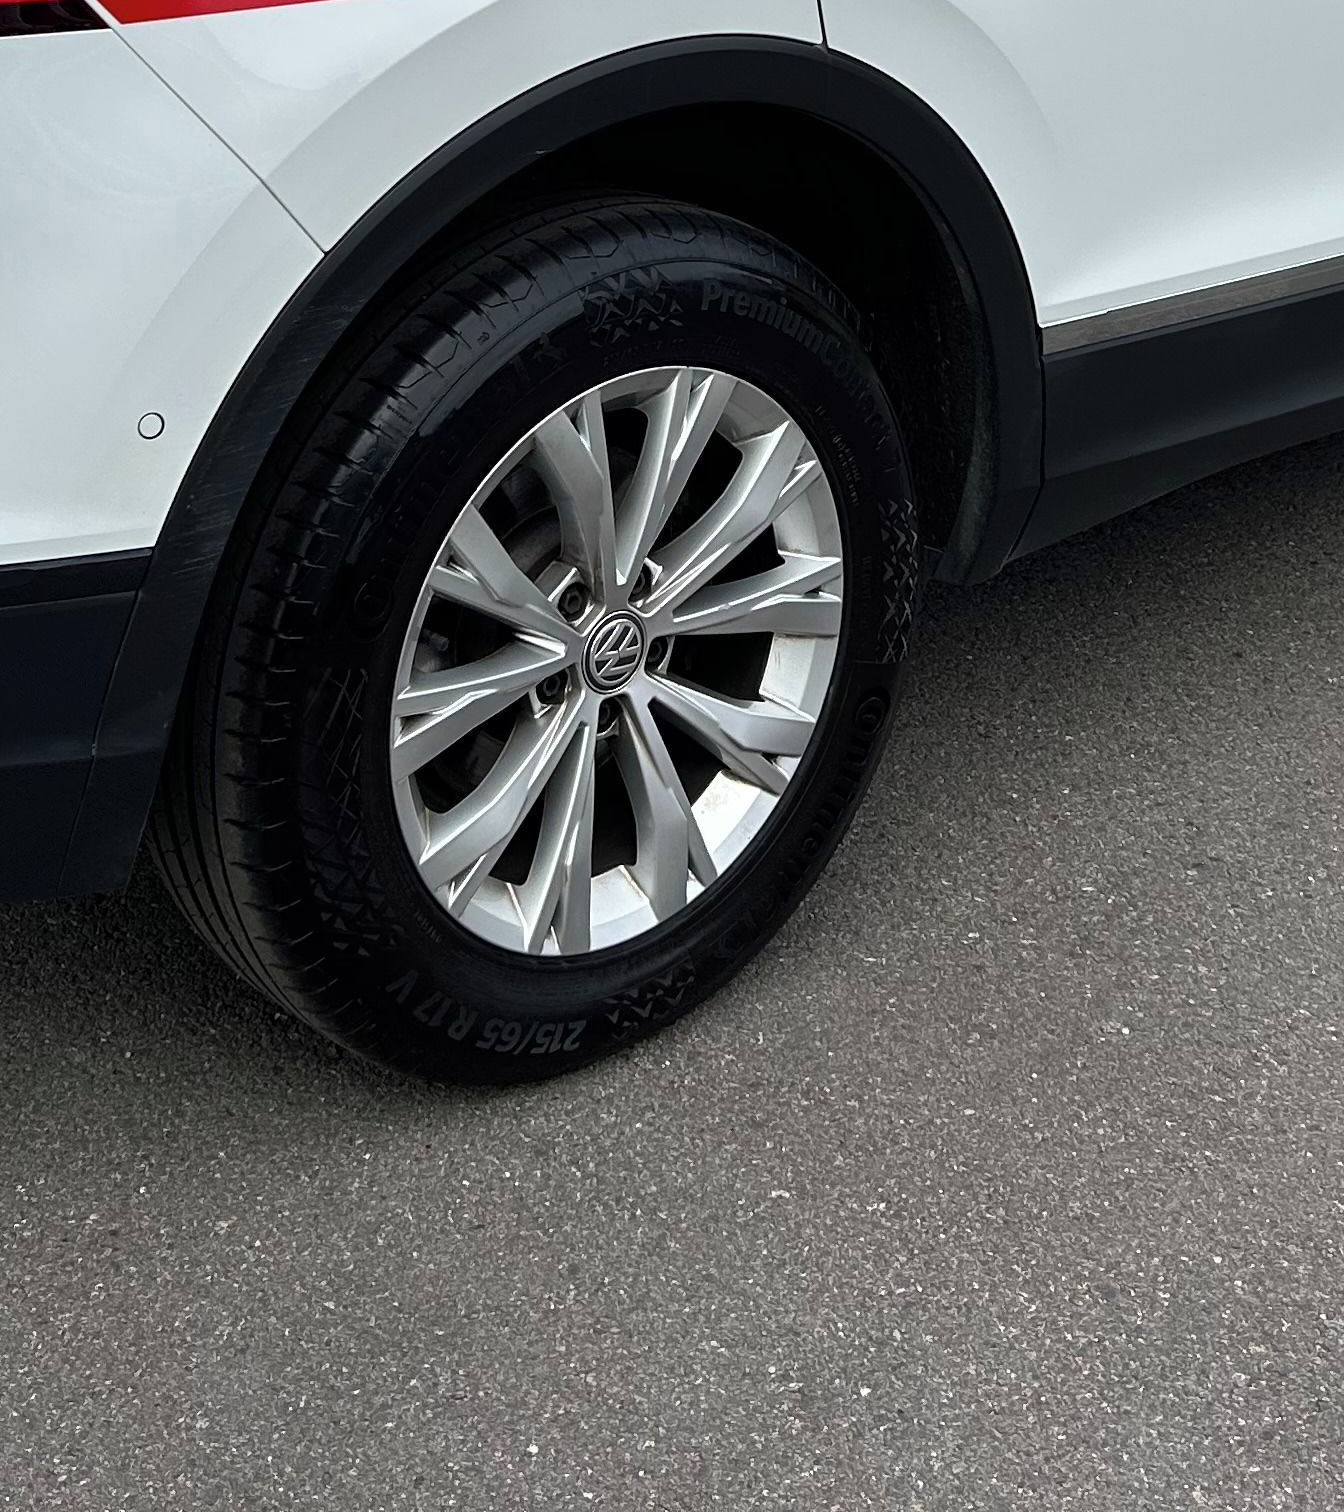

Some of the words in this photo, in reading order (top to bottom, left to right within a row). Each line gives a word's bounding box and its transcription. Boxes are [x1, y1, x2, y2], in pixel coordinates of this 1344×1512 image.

[411, 990, 453, 1028] 17
[447, 1005, 479, 1041] R
[474, 1017, 587, 1056] 215/65
